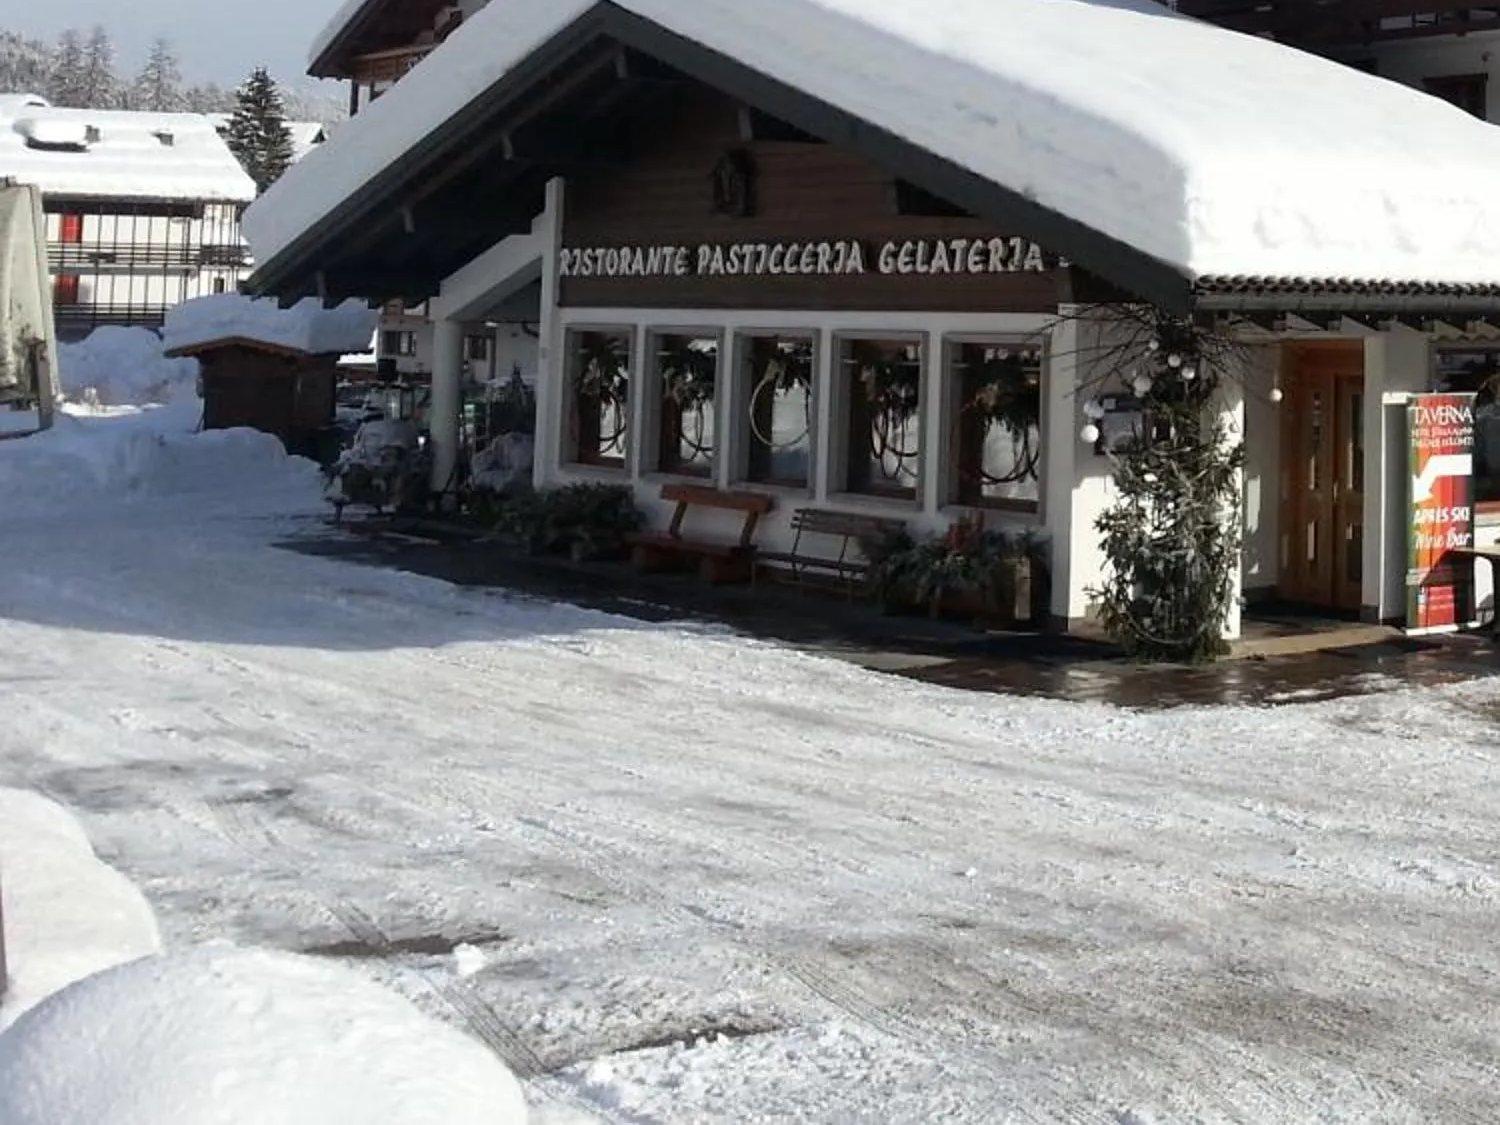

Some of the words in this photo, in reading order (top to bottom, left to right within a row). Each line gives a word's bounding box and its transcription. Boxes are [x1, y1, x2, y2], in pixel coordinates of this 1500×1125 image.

[559, 246, 690, 276] RISTORANTE
[697, 241, 864, 275] PASTICCERIA
[878, 237, 1045, 273] GELATERIA
[1409, 404, 1475, 426] TAVERNA
[1450, 506, 1471, 522] SKI
